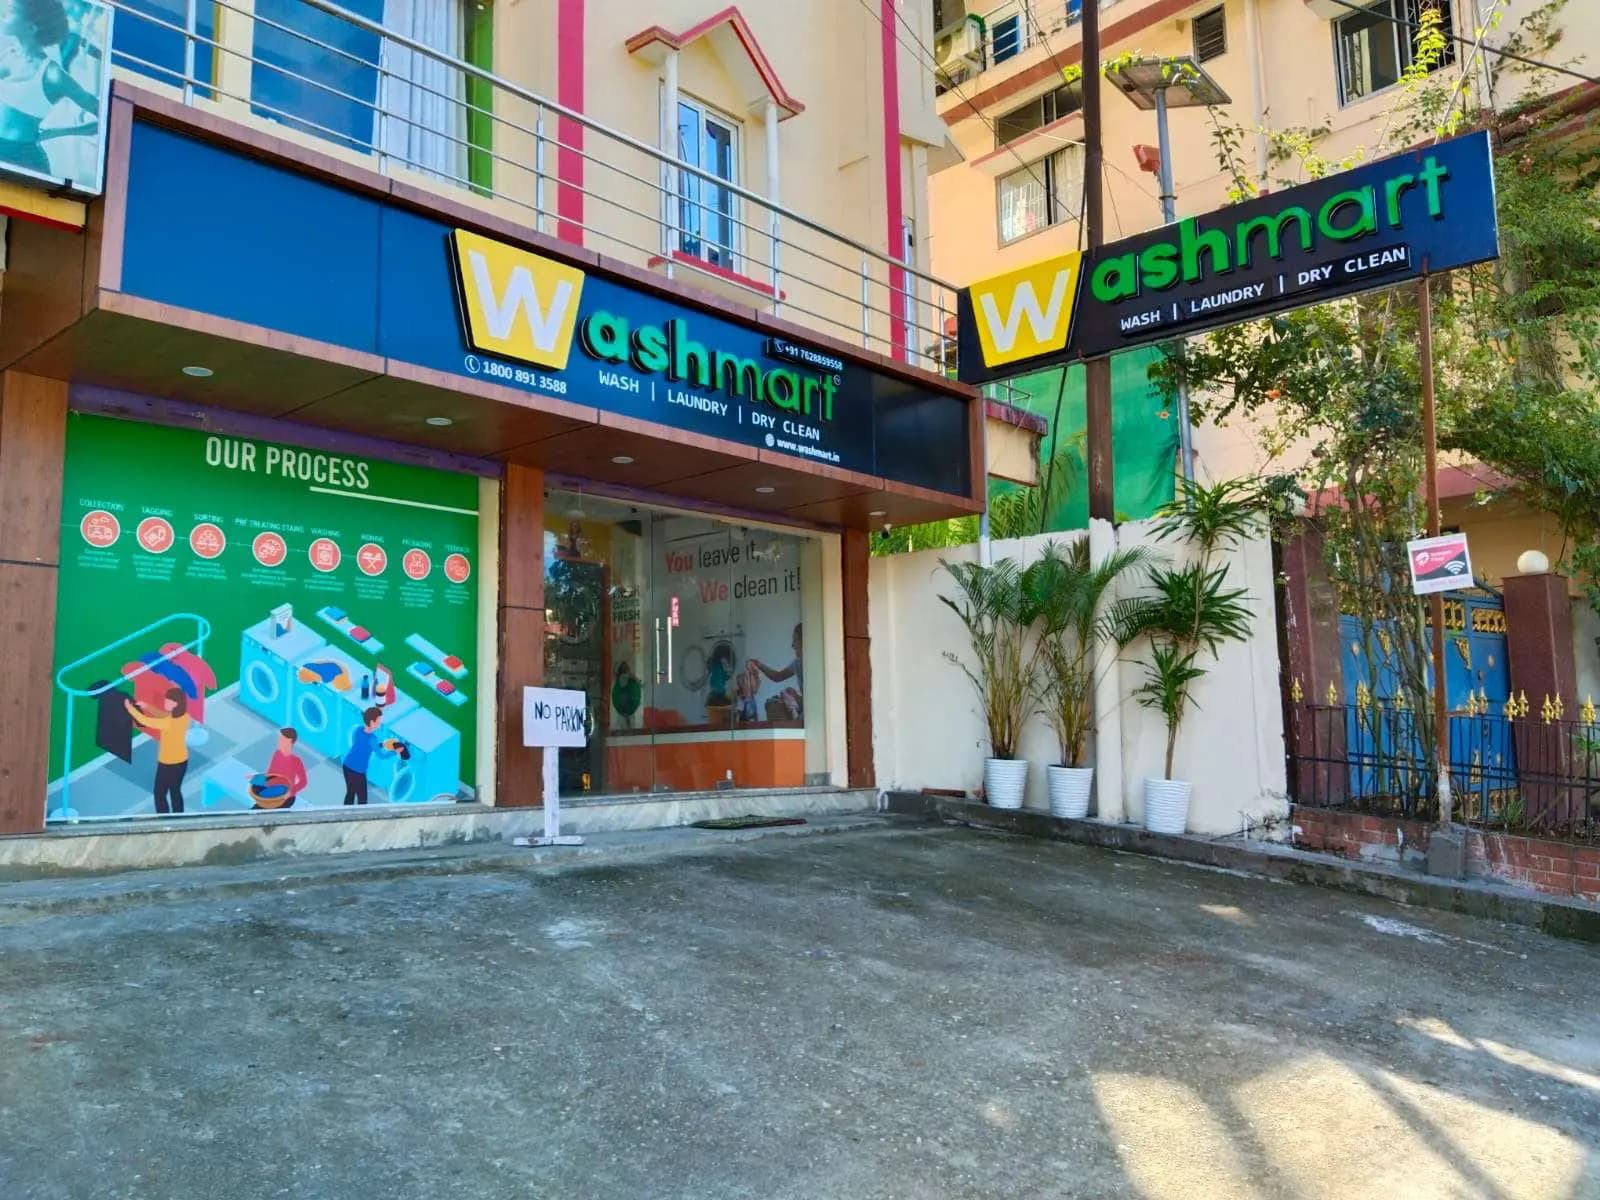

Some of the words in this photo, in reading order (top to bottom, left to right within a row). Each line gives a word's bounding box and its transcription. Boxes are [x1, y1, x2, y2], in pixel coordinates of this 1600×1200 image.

[1120, 311, 1160, 331] WASH
[1191, 283, 1265, 313] LAUNDRY
[1297, 265, 1333, 285] DRY
[1344, 247, 1406, 273] CLEAN
[483, 361, 512, 380] 1800
[515, 370, 536, 386] 891
[539, 376, 567, 394] 3588
[599, 370, 639, 393] WASH
[668, 389, 728, 417] LAUNDRY
[752, 411, 776, 429] DRY
[783, 421, 820, 440] CLEAN
[206, 436, 256, 472] OUR
[266, 446, 369, 489] PROCESS
[776, 439, 840, 462] www.washmart.in
[79, 498, 125, 512] COLLECTION
[664, 552, 693, 574] You
[698, 545, 740, 568] leave
[699, 578, 729, 603] We
[734, 575, 778, 599] clean
[784, 567, 801, 592] it!
[613, 609, 640, 624] FRESH
[535, 700, 551, 720] NO
